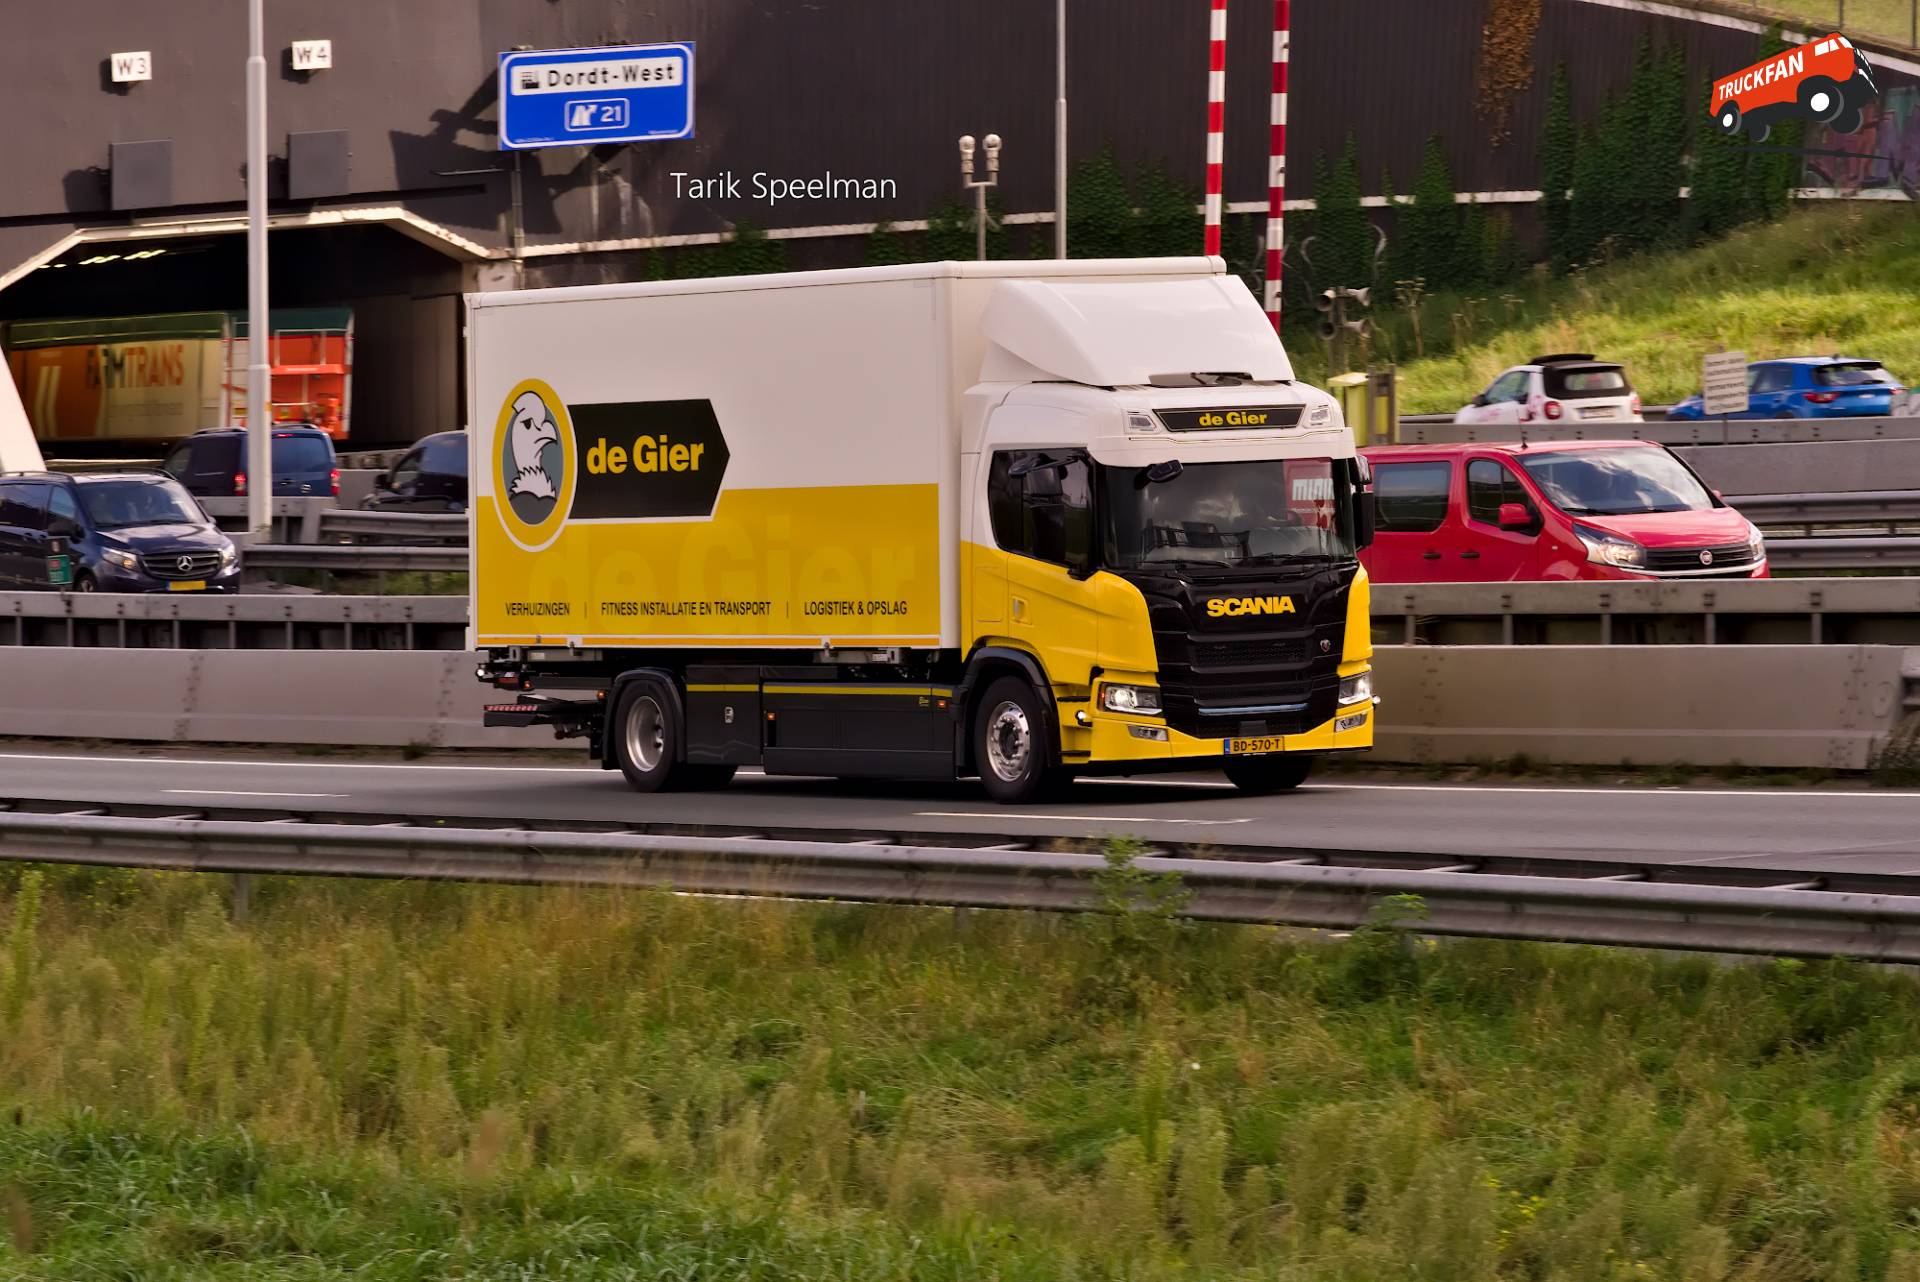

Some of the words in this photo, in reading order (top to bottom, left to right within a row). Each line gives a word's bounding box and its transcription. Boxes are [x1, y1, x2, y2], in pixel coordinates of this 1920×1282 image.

[547, 63, 675, 88] Dordt-West
[600, 105, 622, 123] 21
[1199, 412, 1224, 427] de
[1226, 410, 1268, 426] Gier
[586, 437, 627, 474] de
[632, 433, 705, 473] Gier
[505, 602, 570, 616] VERHUIZINGEN
[601, 602, 638, 616] FITNESS
[640, 602, 697, 616] INSTALLATIE
[699, 602, 712, 616] EN
[714, 601, 771, 616] TRANSPORT
[804, 601, 854, 616] LOGISTIEK
[857, 601, 864, 616] &
[866, 600, 908, 616] OPSLAG
[1206, 595, 1297, 618] SCANIA
[1233, 738, 1281, 752] BD-570-T
